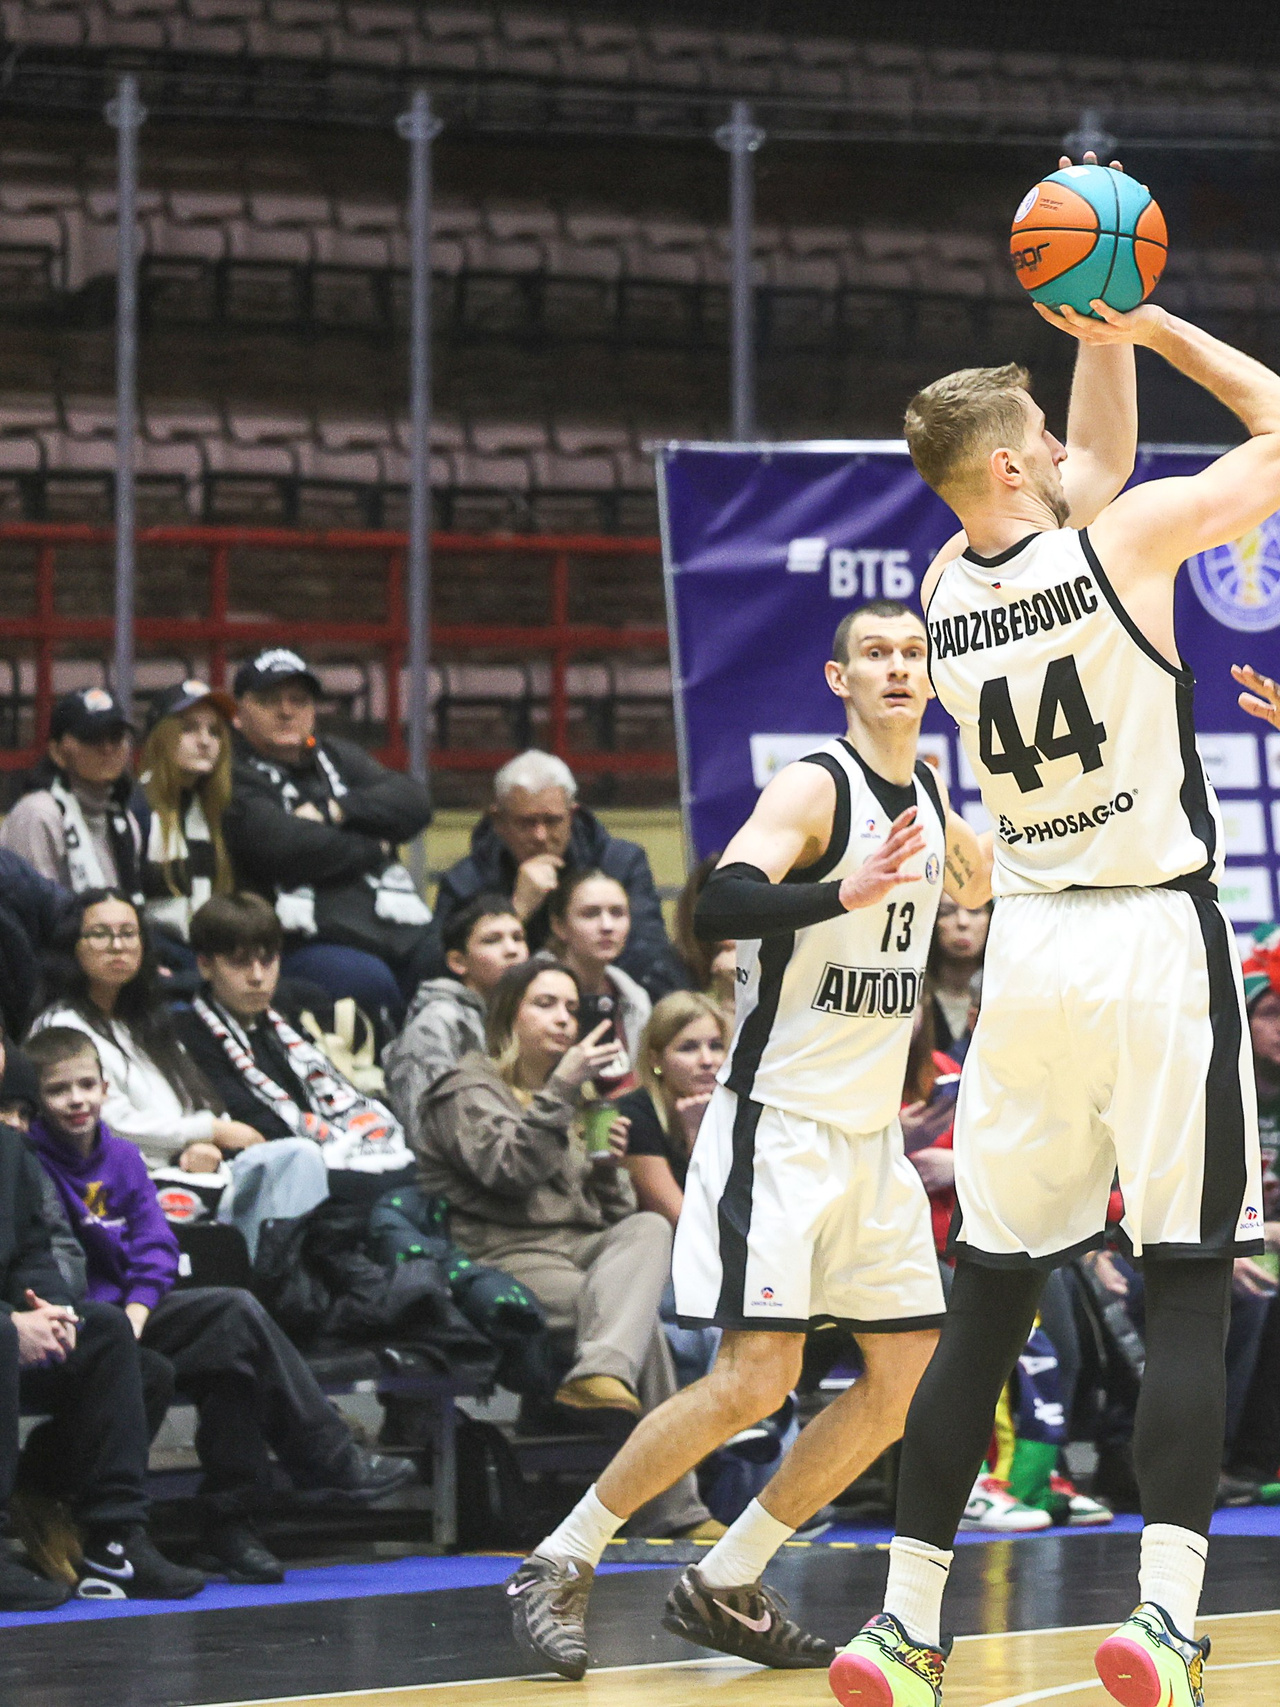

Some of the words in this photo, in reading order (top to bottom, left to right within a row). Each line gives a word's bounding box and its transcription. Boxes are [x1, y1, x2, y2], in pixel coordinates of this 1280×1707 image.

[829, 548, 915, 599] ВТБ
[978, 654, 1107, 794] 44
[881, 902, 915, 953] 13
[811, 961, 926, 1019] AVTOD
